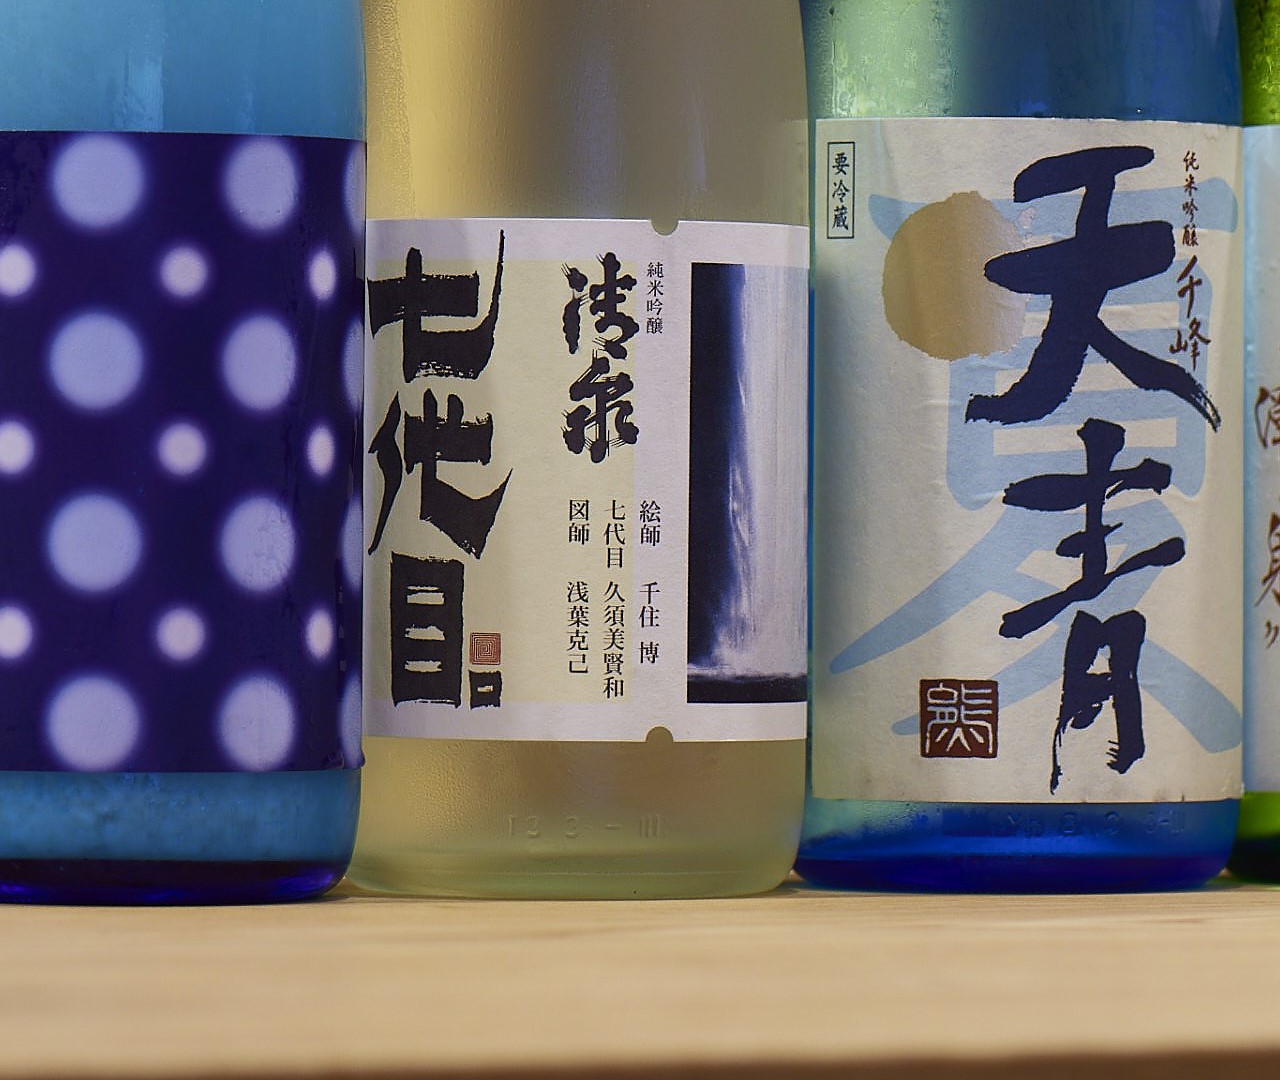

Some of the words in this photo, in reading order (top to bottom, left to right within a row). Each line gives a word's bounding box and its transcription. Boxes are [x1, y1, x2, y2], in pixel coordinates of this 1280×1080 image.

[831, 151, 851, 231] 要冷蔵
[646, 260, 665, 335] 純米吟醸
[1168, 254, 1212, 371] 千峰
[366, 228, 514, 709] 七代目
[964, 145, 1221, 796] 天青
[568, 498, 590, 546] 図師
[604, 498, 626, 569] 七代目
[639, 499, 661, 548] 絵師
[566, 580, 590, 675] 浅葉克己
[603, 580, 626, 699] 久須美賢和
[638, 580, 661, 629] 千住
[639, 640, 660, 665] 博
